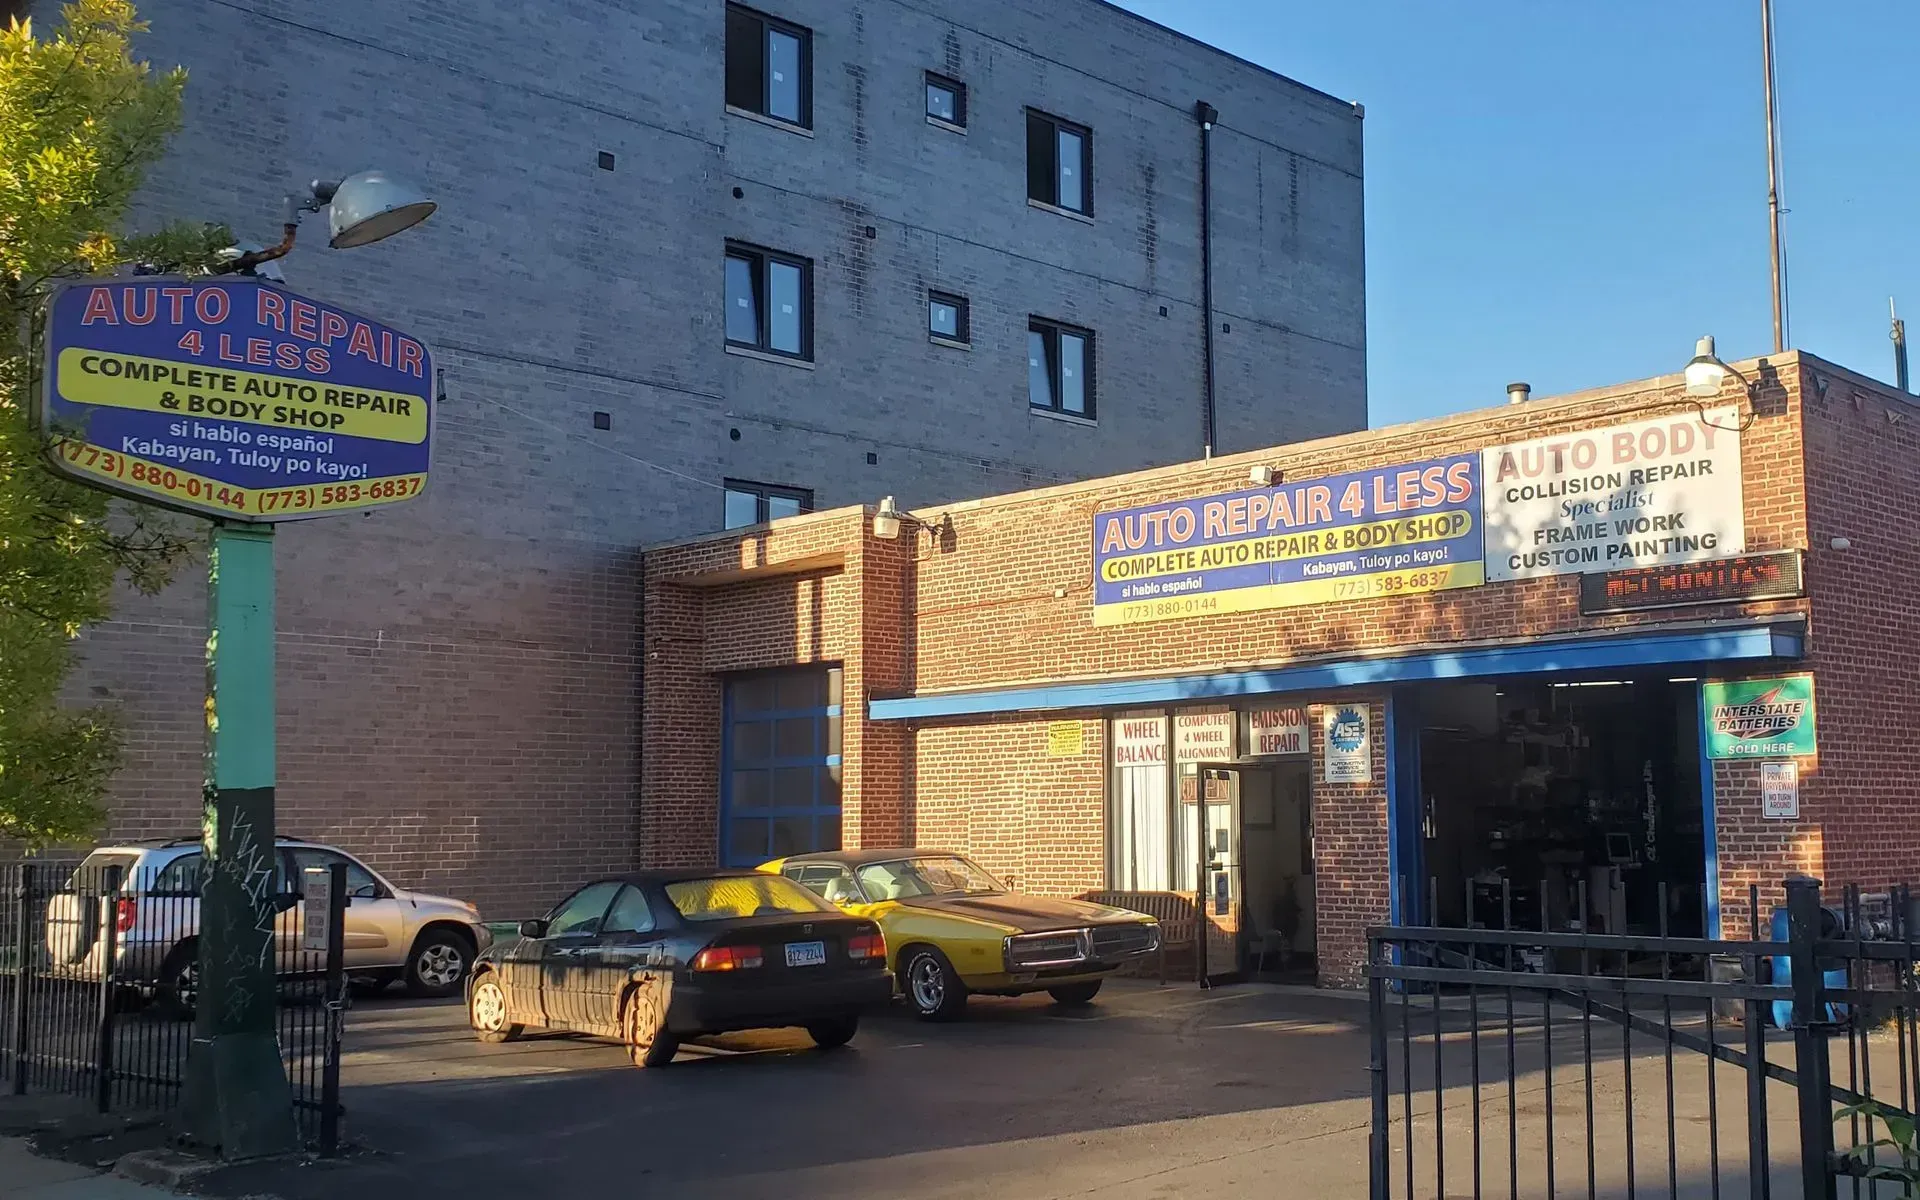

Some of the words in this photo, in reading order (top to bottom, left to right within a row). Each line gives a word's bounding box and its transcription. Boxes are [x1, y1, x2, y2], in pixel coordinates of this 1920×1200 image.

[81, 287, 230, 326] AUTO
[257, 287, 424, 378] REPAIR
[177, 330, 204, 355] 4
[219, 334, 331, 375] LESS
[80, 356, 237, 393] COMPLETE
[244, 377, 317, 404] AUTO
[323, 389, 411, 416] REPAIR
[159, 391, 180, 409] &
[188, 396, 266, 420] BODY
[273, 406, 345, 429] SHOP
[169, 421, 188, 437] si
[193, 422, 251, 446] hablo
[256, 431, 334, 454] español
[1496, 438, 1597, 483] AUTO
[1612, 416, 1723, 465] BODY
[122, 436, 222, 465] Kabayan,
[227, 448, 281, 474] Tuloy
[286, 458, 312, 475] po
[316, 459, 368, 480] kayo!
[58, 442, 125, 478] (773)
[131, 462, 246, 509] 880-0144
[1506, 472, 1622, 503] COLLISION
[1629, 459, 1713, 485] REPAIR
[257, 487, 315, 512] (773)
[321, 477, 421, 505] 583-6837
[1101, 507, 1196, 554] AUTO
[1203, 485, 1333, 539] REPAIR
[1338, 480, 1364, 518] 4
[1373, 462, 1473, 513] LESS
[1560, 489, 1654, 521] Specialist
[1533, 521, 1608, 546] FRAME
[1614, 513, 1685, 536] WORK
[1108, 554, 1196, 579] COMPLETE
[1200, 545, 1250, 567] AUTO
[1254, 535, 1319, 559] REPAIR
[1324, 531, 1339, 549] &
[1343, 522, 1401, 549] BODY
[1405, 513, 1465, 541] SHOP
[1303, 557, 1357, 577] Kabayan,
[1358, 553, 1392, 572] Tuloy
[1394, 551, 1410, 567] po
[1413, 546, 1448, 564] kayo!
[1508, 542, 1599, 570] CUSTOM
[1606, 533, 1718, 560] PAINTING
[1122, 585, 1131, 597] si
[1132, 582, 1161, 597] hablo
[1162, 576, 1203, 595] español
[1333, 580, 1371, 599] (773)
[1375, 570, 1450, 593] 583-6837
[1122, 602, 1155, 619] (773)
[1156, 597, 1218, 615] 880-0144
[1178, 714, 1229, 728] COMPUTER
[1252, 708, 1308, 729] EMISSION
[1714, 702, 1803, 718] INTERSTATE
[1718, 716, 1796, 731] BATTERIES
[1123, 721, 1160, 739] WHEEL
[1184, 733, 1190, 743] 4
[1193, 731, 1224, 743] WHEEL
[1260, 733, 1300, 753] REPAIR
[1334, 721, 1360, 737] ASE
[1117, 744, 1166, 763] BALANCE
[1178, 747, 1230, 759] ALIGNMENT
[1728, 744, 1759, 754] SOLD
[1762, 743, 1795, 753] HERE
[1767, 772, 1791, 780] PRIVATE
